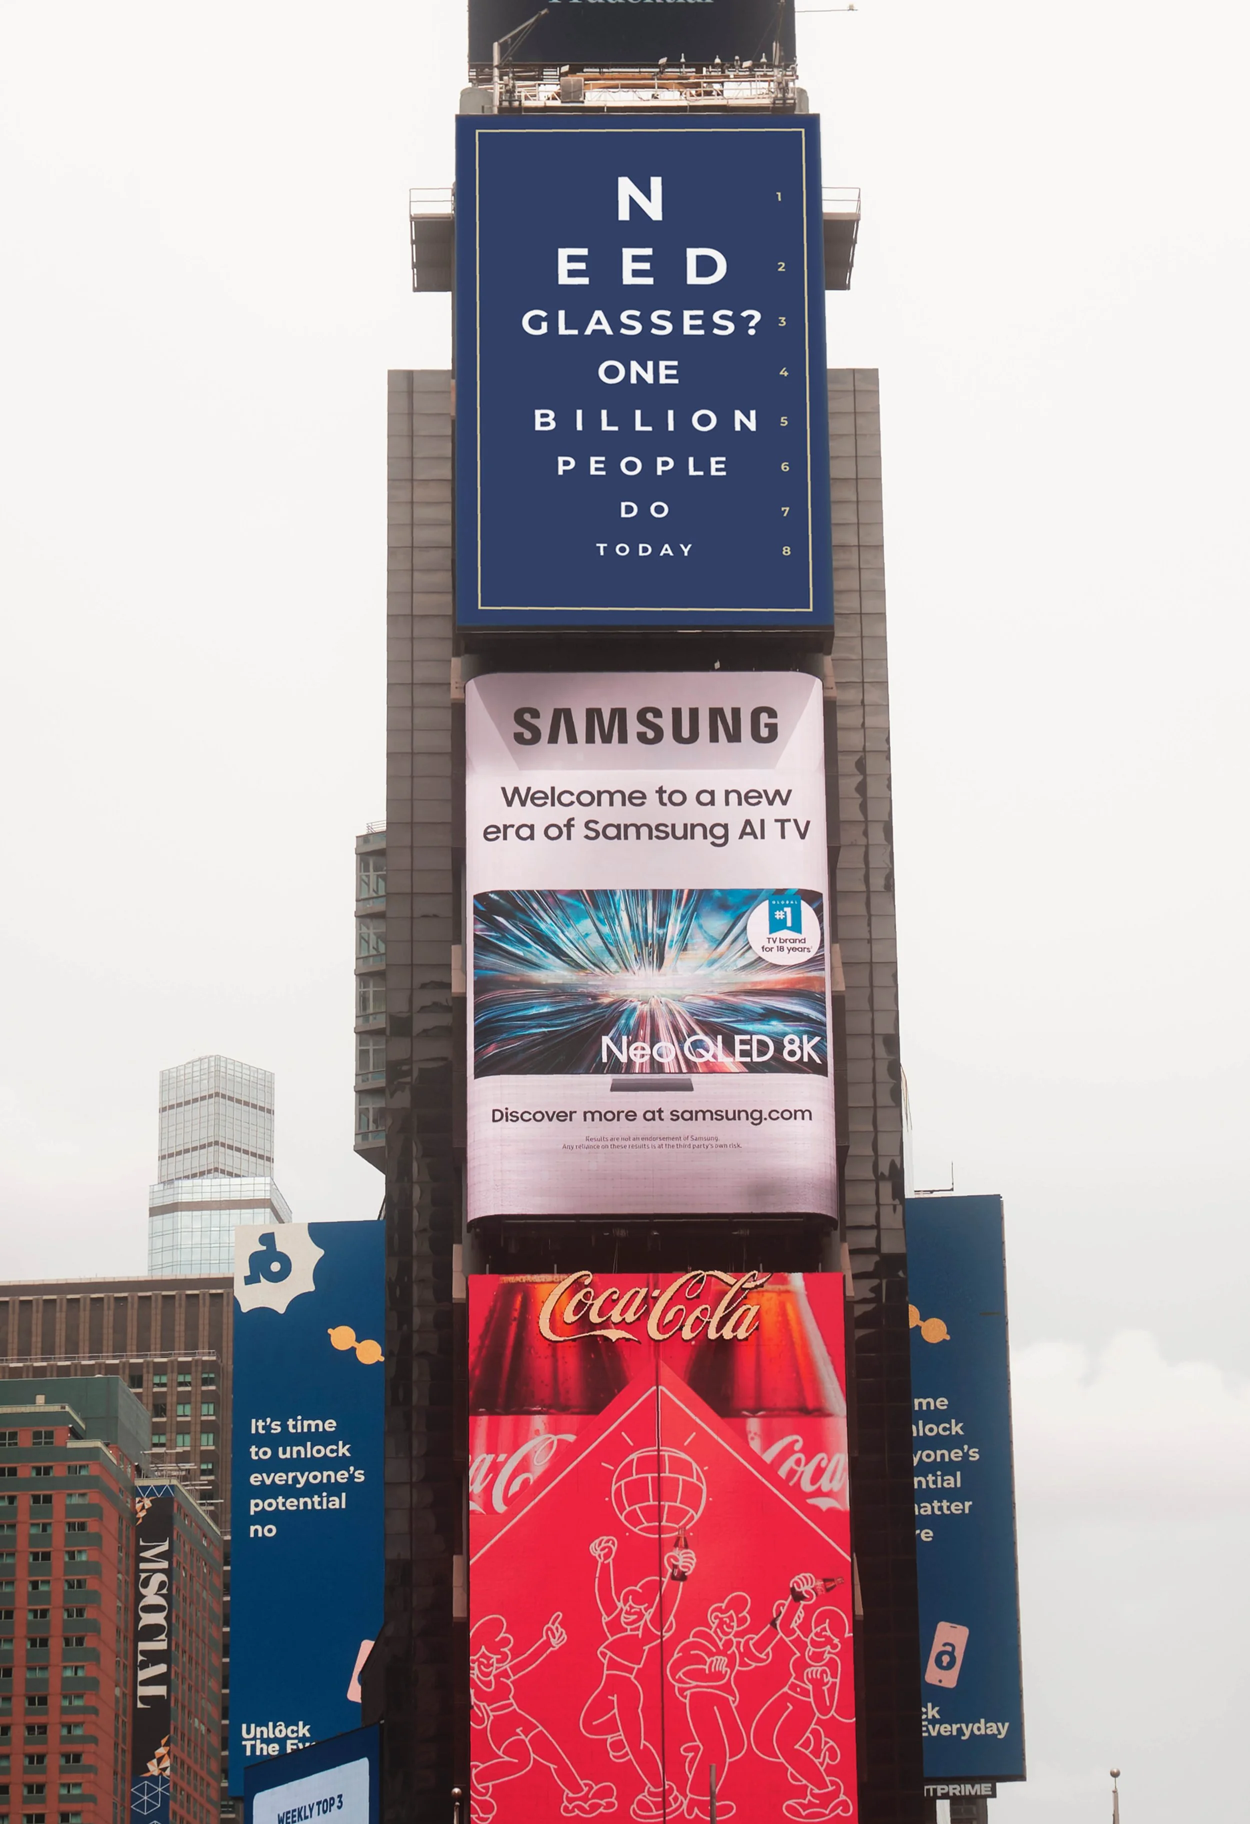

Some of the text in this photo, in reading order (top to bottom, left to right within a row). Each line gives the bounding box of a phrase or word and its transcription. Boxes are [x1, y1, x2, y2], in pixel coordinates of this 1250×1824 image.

[617, 176, 663, 221] N
[776, 192, 783, 202] 1
[777, 261, 786, 273] 2
[521, 309, 763, 336] GLASSES?
[778, 316, 787, 328] 3
[597, 360, 680, 385] ONE
[779, 367, 789, 378] 4
[533, 408, 758, 432] BILLION
[780, 416, 788, 428] 5
[557, 456, 727, 476] PEOPLE
[781, 461, 790, 473] 6
[620, 501, 669, 518] DO
[781, 506, 790, 518] 7
[596, 542, 693, 557] TODAY
[782, 545, 791, 557] 8
[513, 706, 779, 746] SAMSUNG
[501, 785, 793, 807] Welcome to a new
[483, 817, 811, 848] era of Samsung AI TV
[774, 907, 792, 927] #1
[761, 945, 774, 953] for
[602, 1034, 823, 1064] Neo QLED 8K
[491, 1107, 812, 1126] Discover more at samsung.com
[539, 1270, 772, 1343] Coca-Cola
[251, 1415, 337, 1434] It's time
[249, 1441, 351, 1459] to unlock
[249, 1466, 365, 1487] everyone's
[249, 1492, 346, 1515] potential
[249, 1524, 277, 1537] no
[242, 1739, 279, 1756] The
[277, 1793, 344, 1824] WEEKLY TOP 3
